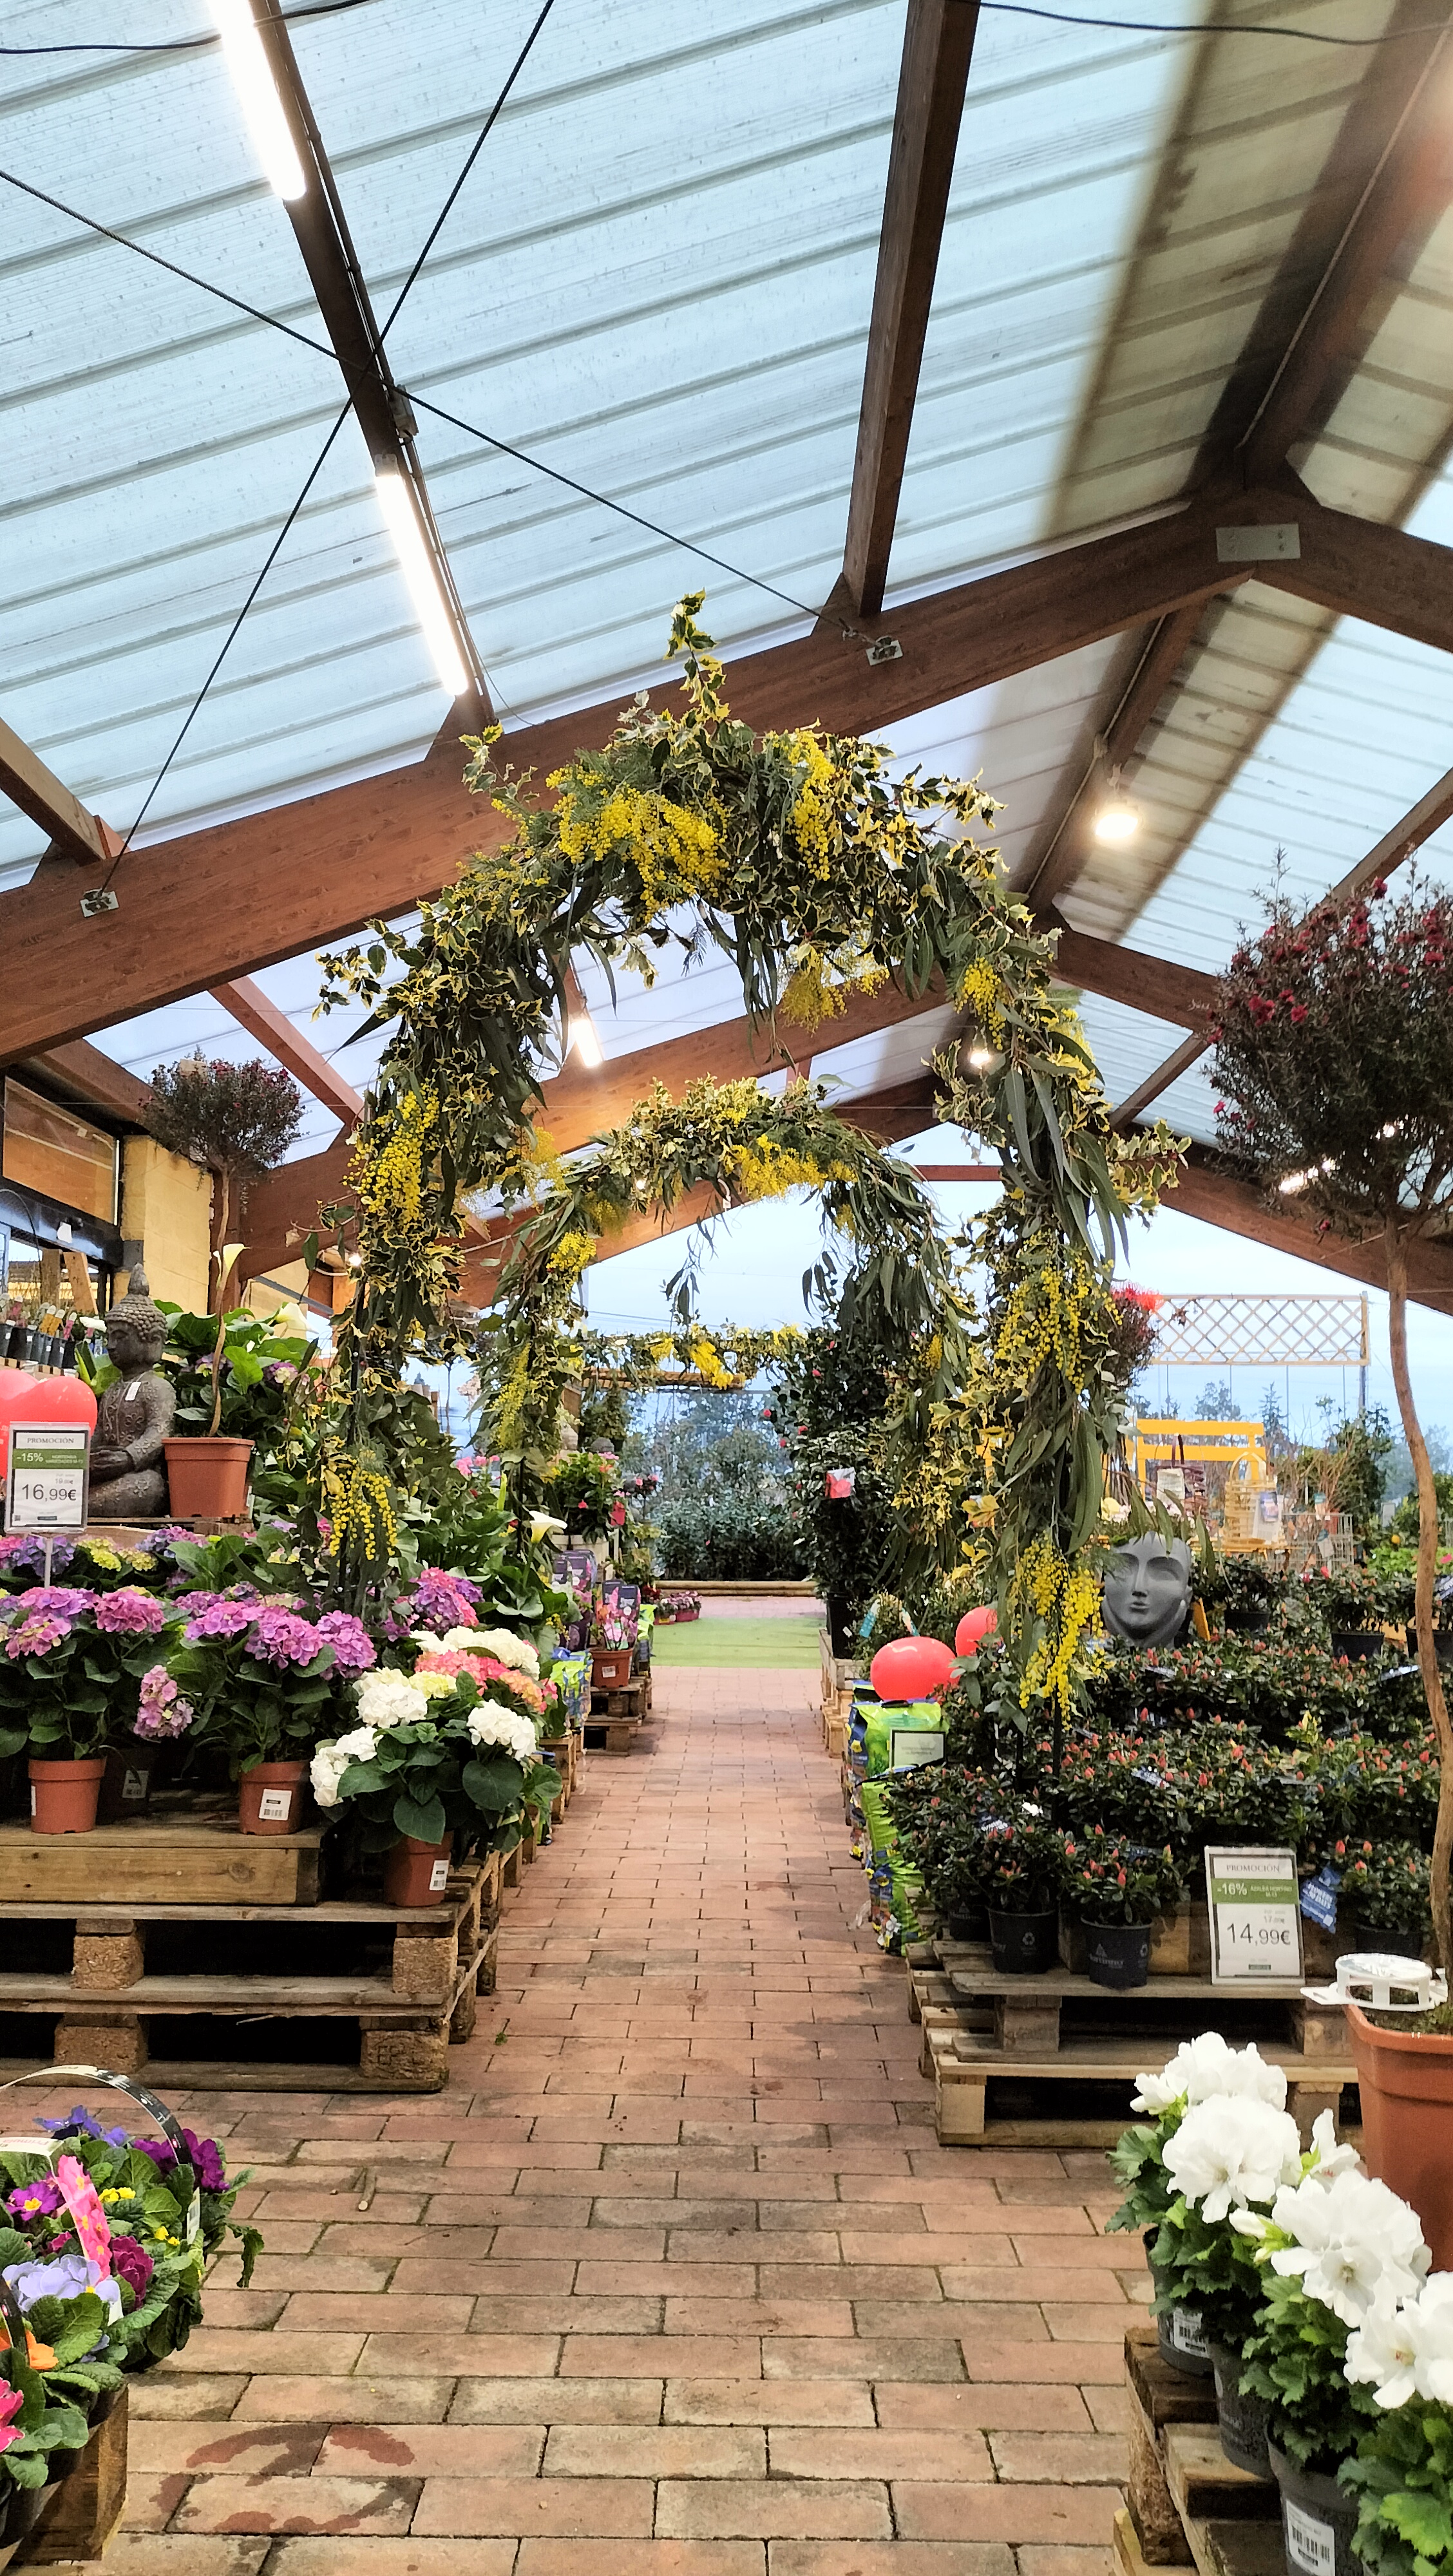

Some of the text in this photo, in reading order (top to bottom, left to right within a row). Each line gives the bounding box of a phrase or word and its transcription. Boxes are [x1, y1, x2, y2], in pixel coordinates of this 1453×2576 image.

[16, 1452, 44, 1463] -15%
[22, 1484, 77, 1502] 16,99€
[1226, 1863, 1280, 1873] PROMOCIÓN
[1217, 1882, 1248, 1896] -16%
[1227, 1923, 1291, 1946] 14,99€
